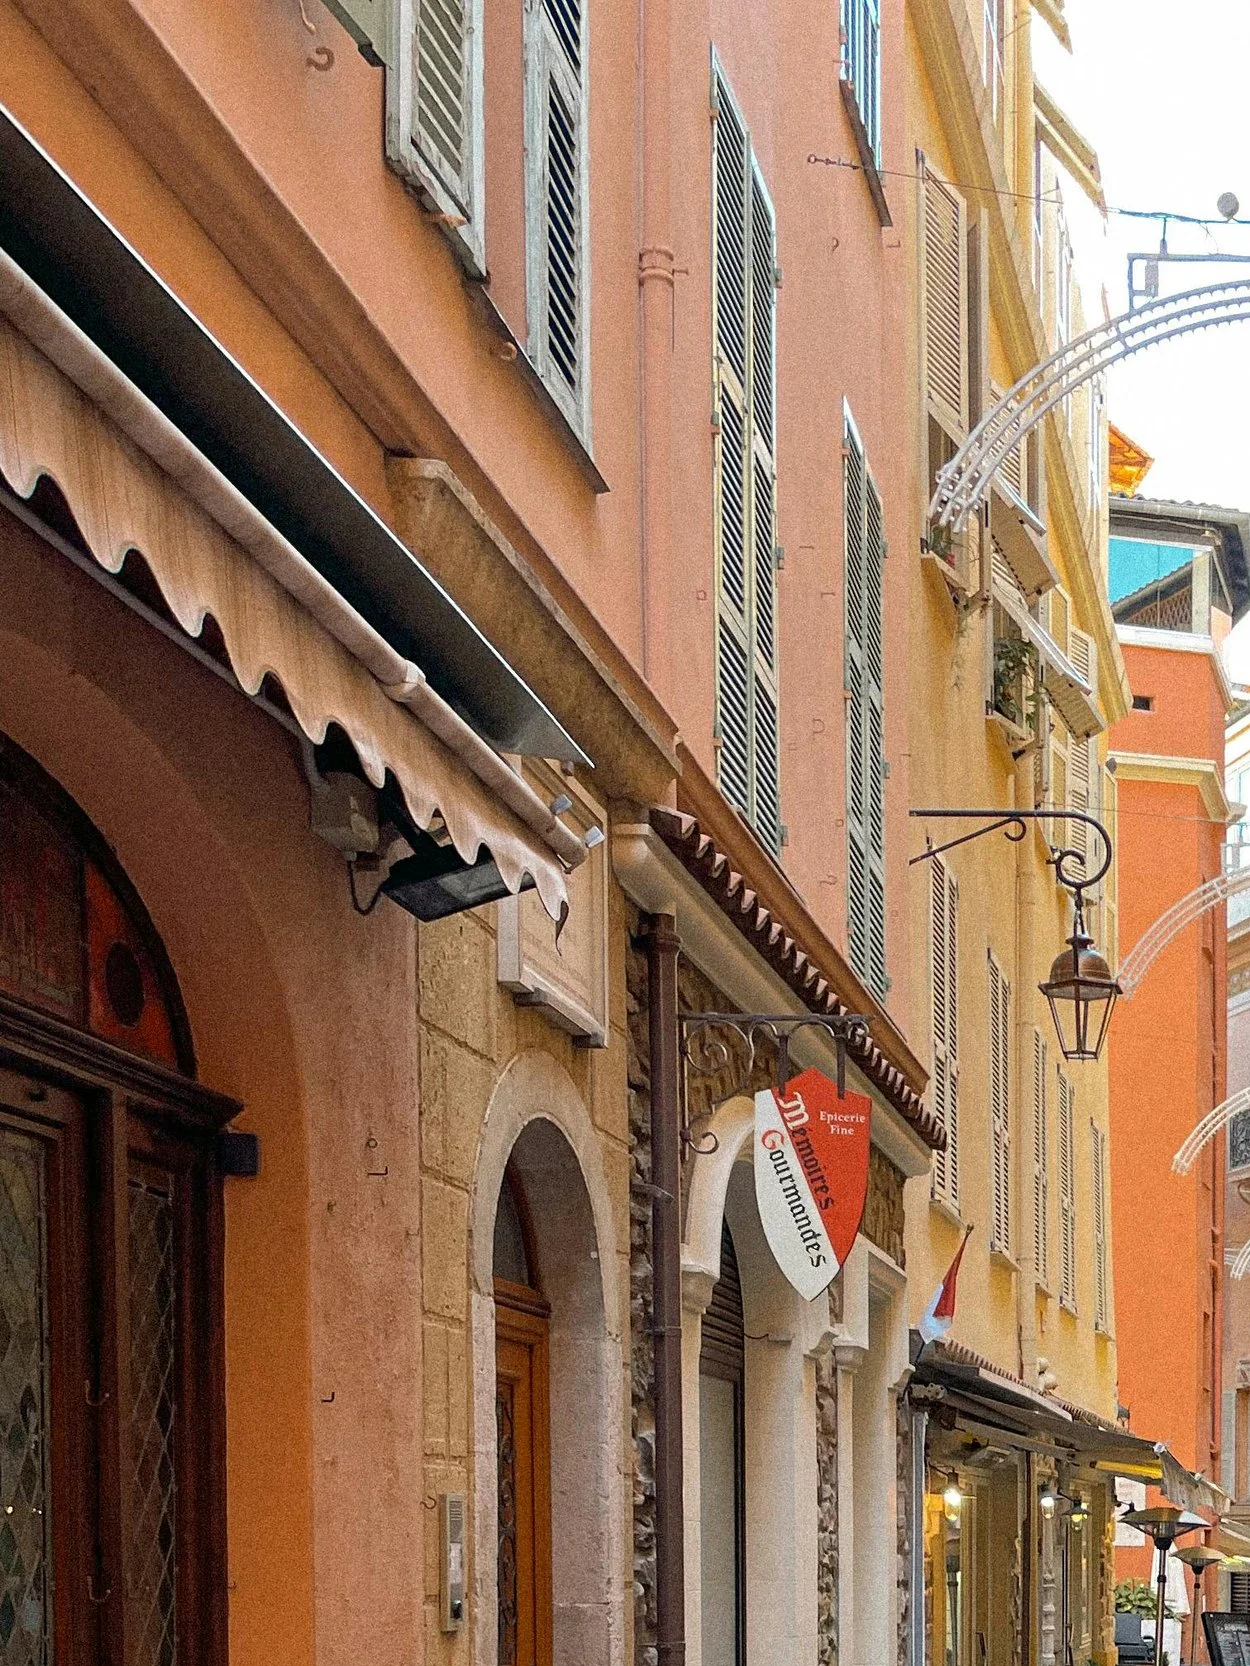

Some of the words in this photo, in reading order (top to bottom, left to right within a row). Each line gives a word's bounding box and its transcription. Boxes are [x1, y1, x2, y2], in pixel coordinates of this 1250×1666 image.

[819, 1110, 866, 1124] Epicerie
[830, 1124, 855, 1136] Fine
[761, 1129, 827, 1268] Gourmandes
